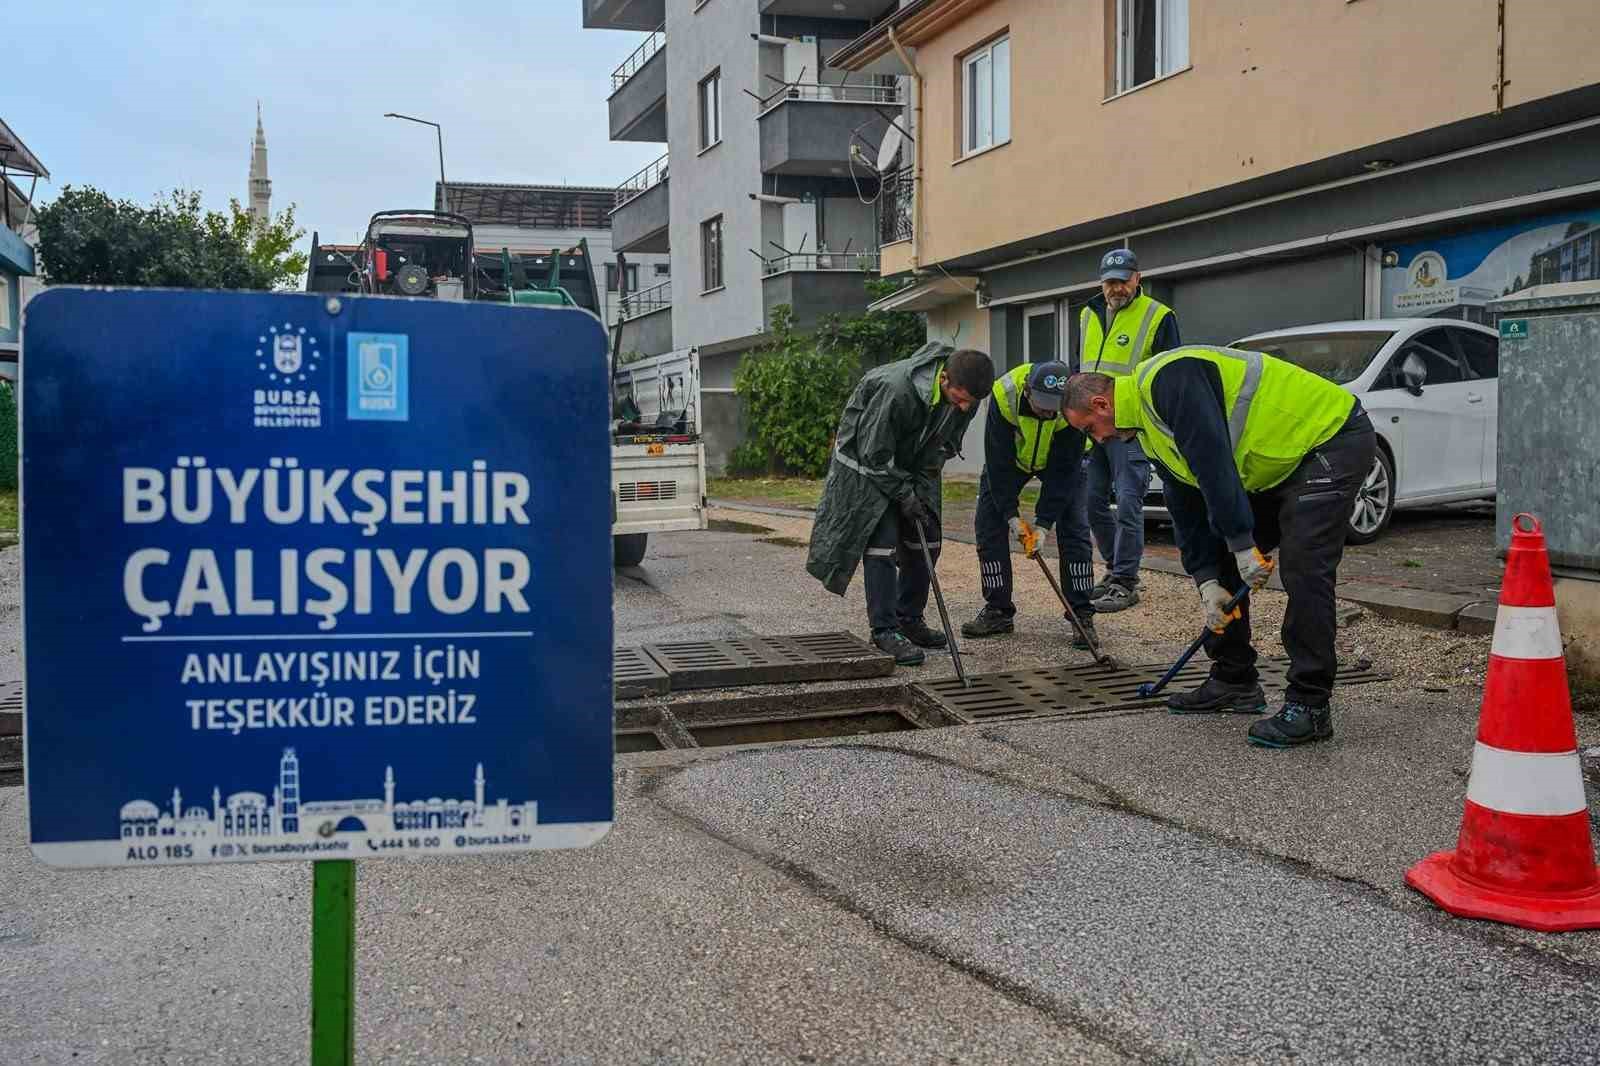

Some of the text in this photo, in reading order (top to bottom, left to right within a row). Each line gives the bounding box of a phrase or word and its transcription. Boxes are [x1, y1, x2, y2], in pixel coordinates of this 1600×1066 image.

[254, 390, 320, 405] BURSA
[124, 457, 530, 536] BÜYÜKŞEHİR
[124, 548, 530, 632] ÇALIŞIYOR
[182, 645, 479, 687] ANLAYIŞINIZ İÇİN
[186, 690, 476, 734] TEŞEKKÜR EDERİZ
[127, 845, 193, 860] ALO 185
[381, 837, 403, 848] 444
[424, 836, 440, 847] 00
